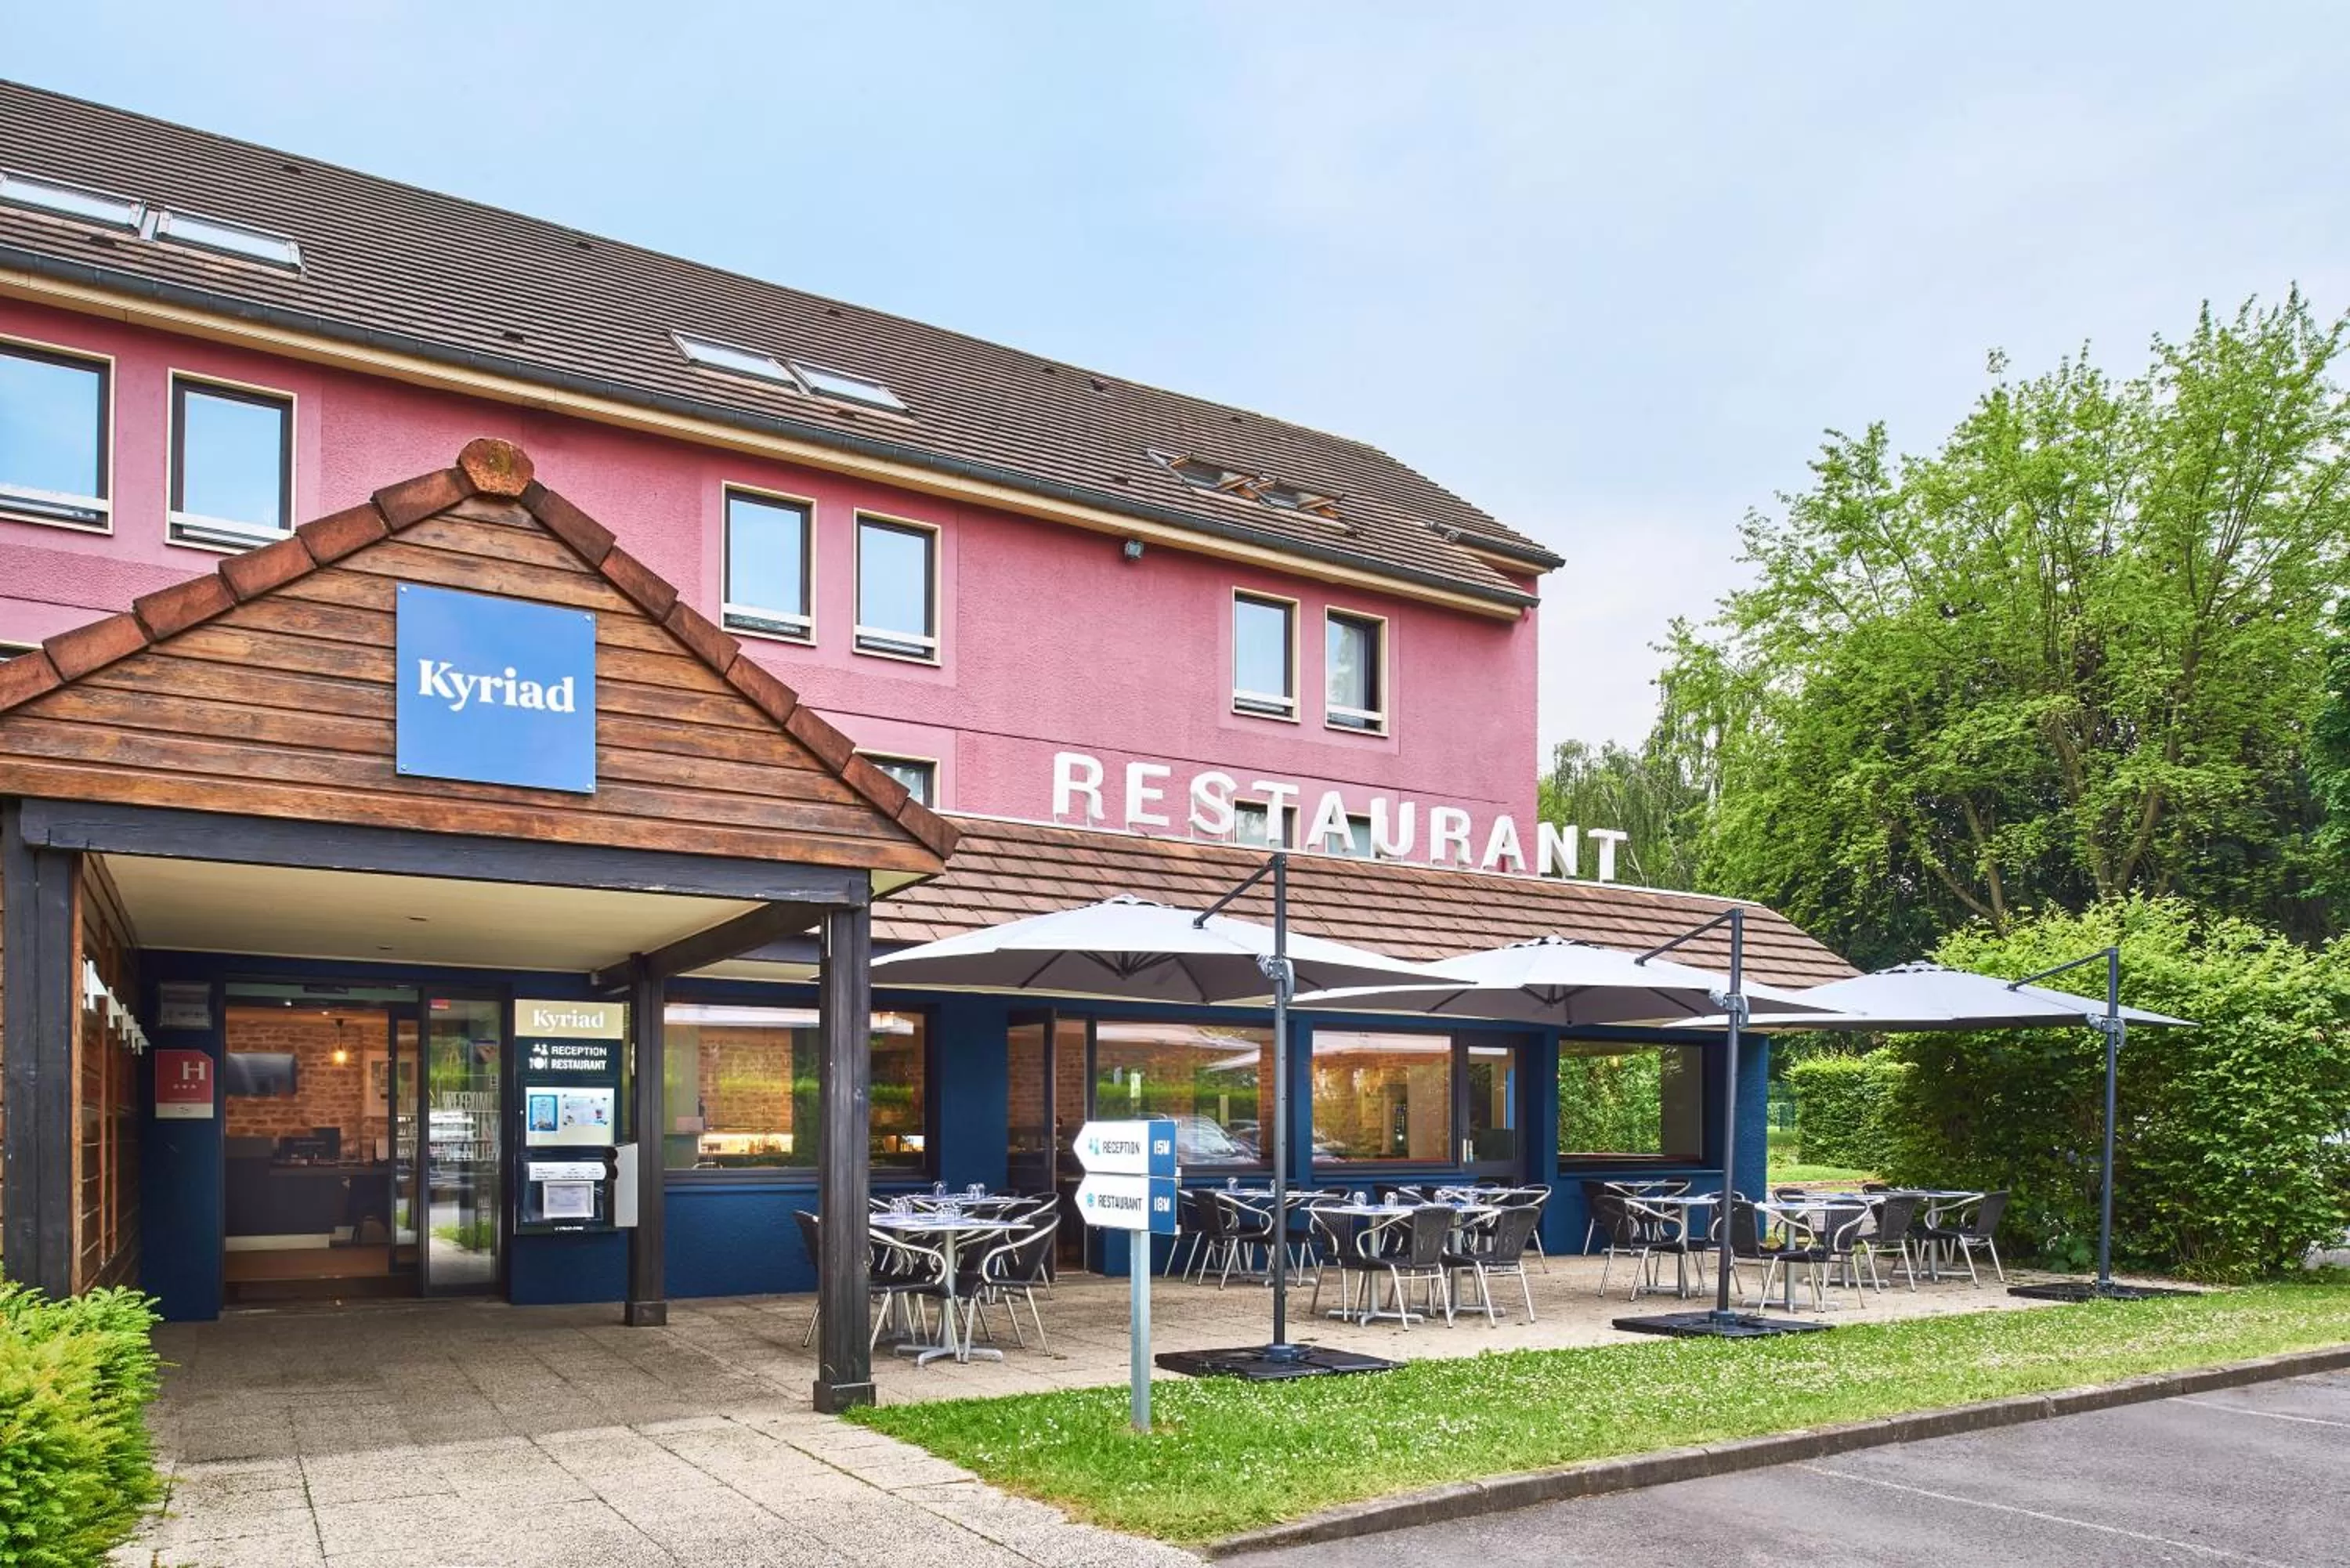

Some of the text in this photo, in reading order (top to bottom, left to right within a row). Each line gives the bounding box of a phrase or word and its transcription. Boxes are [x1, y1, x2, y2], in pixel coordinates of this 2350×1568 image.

[418, 659, 576, 713] Kyriad
[1053, 751, 1627, 882] RESTAURANT
[533, 1009, 604, 1031] Kyriad
[551, 1046, 607, 1056] RECEPTION
[183, 1061, 205, 1080] H
[551, 1058, 606, 1070] RESTAURANT
[1154, 1140, 1170, 1155] 15M
[1098, 1194, 1170, 1212] RESTAURANT 18M
